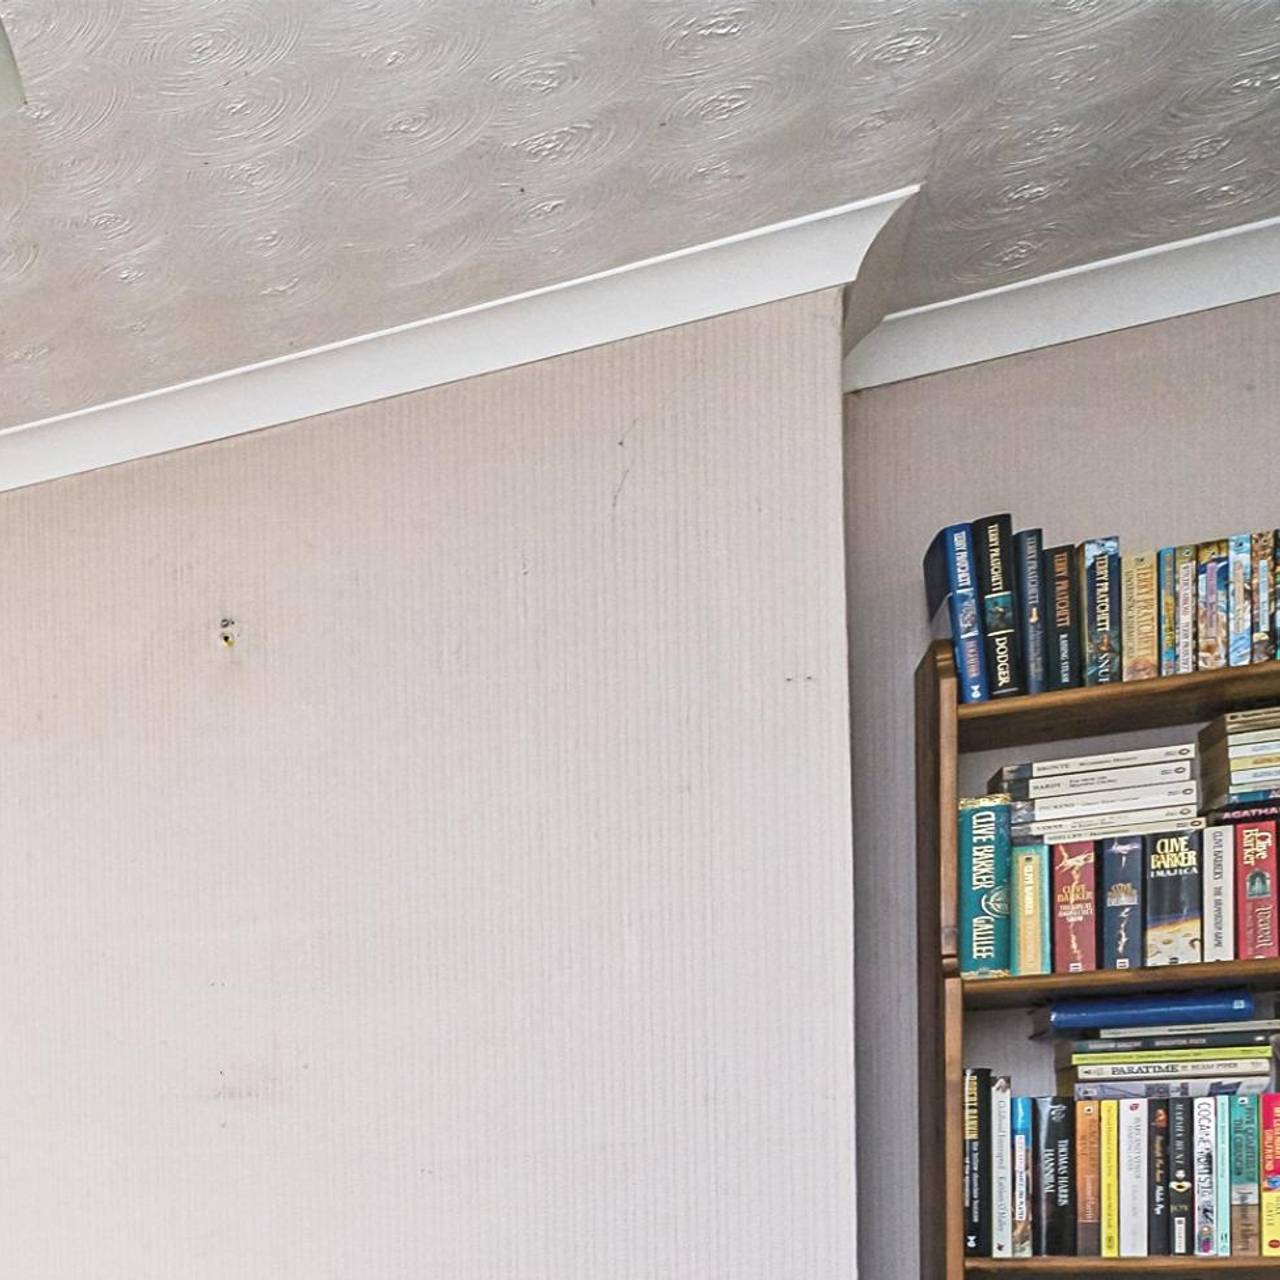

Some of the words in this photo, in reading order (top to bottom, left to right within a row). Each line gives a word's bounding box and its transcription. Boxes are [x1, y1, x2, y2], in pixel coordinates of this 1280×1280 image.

[987, 524, 1000, 548] TERRY
[990, 549, 1004, 592] PRATCHETT
[1053, 552, 1070, 577] TERRY
[1096, 555, 1109, 580] TERRY
[1055, 578, 1071, 627] PRATCHETT
[1096, 581, 1110, 632] PRATCHETT
[994, 637, 1011, 687] DODGER
[972, 811, 995, 842] CLIVE
[1150, 851, 1196, 869] BARKER
[1157, 836, 1188, 853] CLIVE
[1243, 828, 1257, 866] Barker
[1257, 830, 1272, 859] Clive
[972, 846, 995, 890] BARKER
[1150, 867, 1199, 878] IMAJICA
[972, 916, 995, 960] GALILEE
[1111, 1064, 1179, 1076] PARATIME
[1044, 1149, 1054, 1194] HANNIBAL
[1057, 1139, 1069, 1175] THOMAS
[1057, 1177, 1068, 1206] HARRIS
